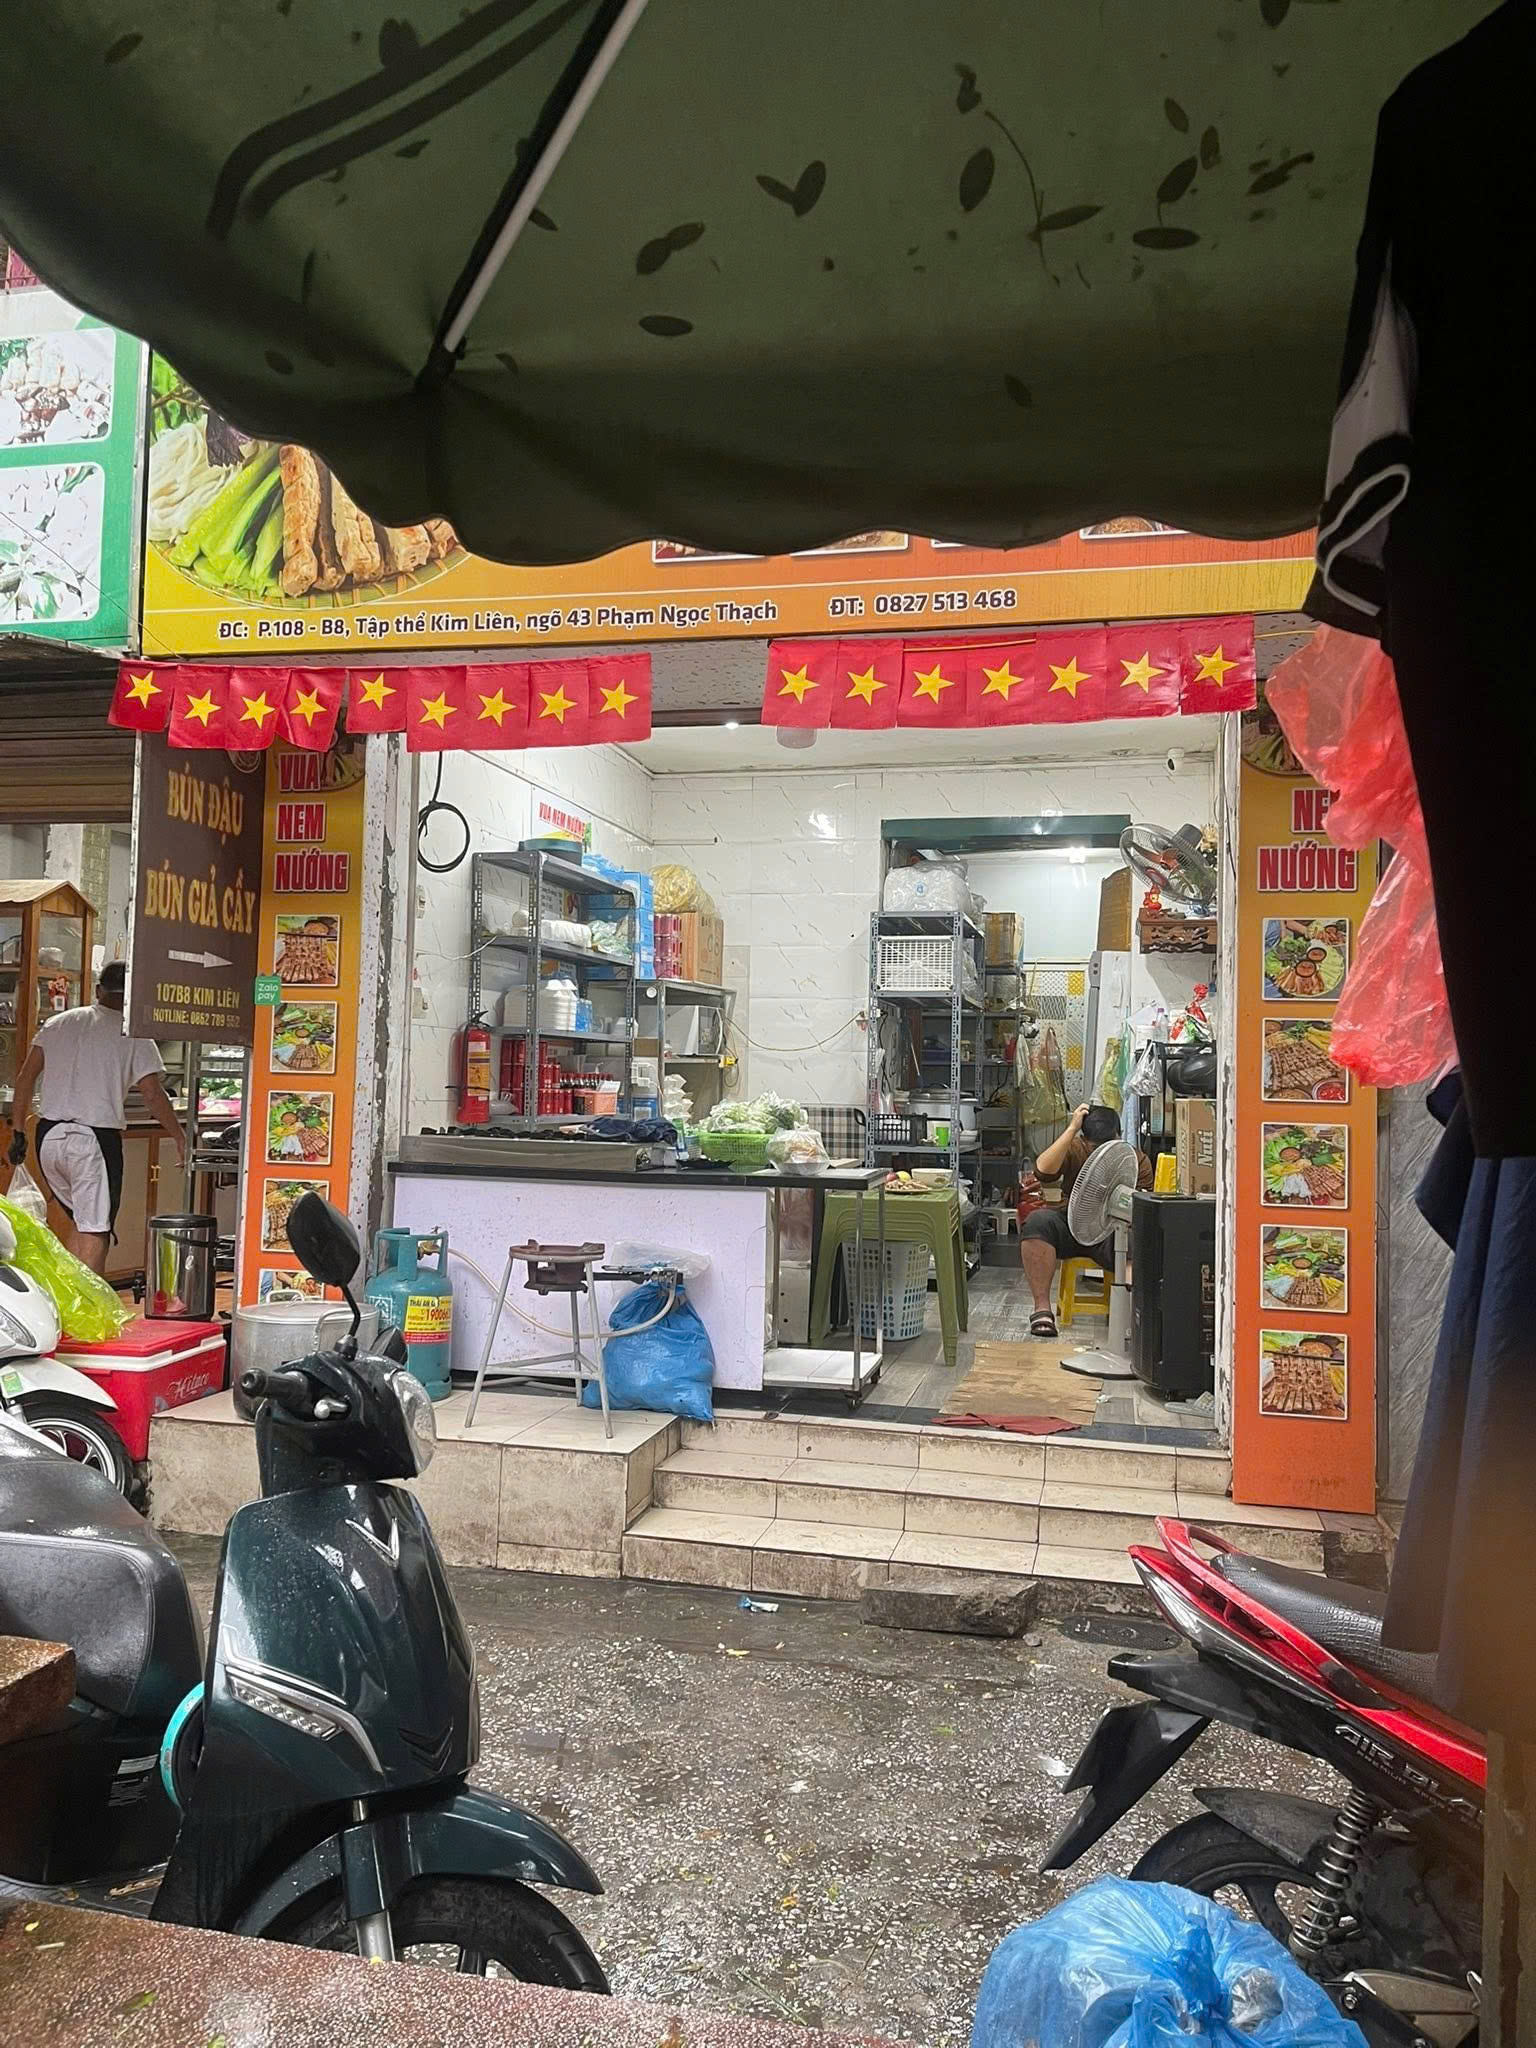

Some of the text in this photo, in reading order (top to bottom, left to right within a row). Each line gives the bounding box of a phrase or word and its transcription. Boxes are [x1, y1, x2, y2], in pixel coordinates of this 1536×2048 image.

[219, 622, 248, 639] ĐC:
[257, 620, 304, 638] P.108
[321, 618, 350, 638] B8,
[355, 616, 390, 639] Tập
[394, 611, 426, 633] thể
[430, 613, 468, 632] Kim
[474, 612, 521, 633] Liên,
[526, 610, 562, 633] ngõ
[566, 609, 591, 626] 43
[597, 607, 654, 630] Phạm
[660, 605, 710, 628] Ngọc
[714, 600, 777, 625] Thạch
[829, 589, 1016, 616] ĐT: 0827 513 468
[279, 752, 321, 791] VUA
[207, 775, 244, 847] ĐẬU
[277, 803, 325, 841] NEM
[1292, 788, 1340, 833] NE
[275, 847, 349, 892] NƯỚNG
[1257, 838, 1358, 892] NƯỚNG
[188, 863, 219, 929] GIẢ
[156, 983, 240, 1009] 107B8 KIM LIÊN
[257, 992, 276, 1001] pay
[258, 983, 279, 992] Zalo
[153, 1007, 189, 1024] HOTLINE:
[1197, 1129, 1214, 1169] Nuti
[1334, 1724, 1487, 1825] AIR BLA
